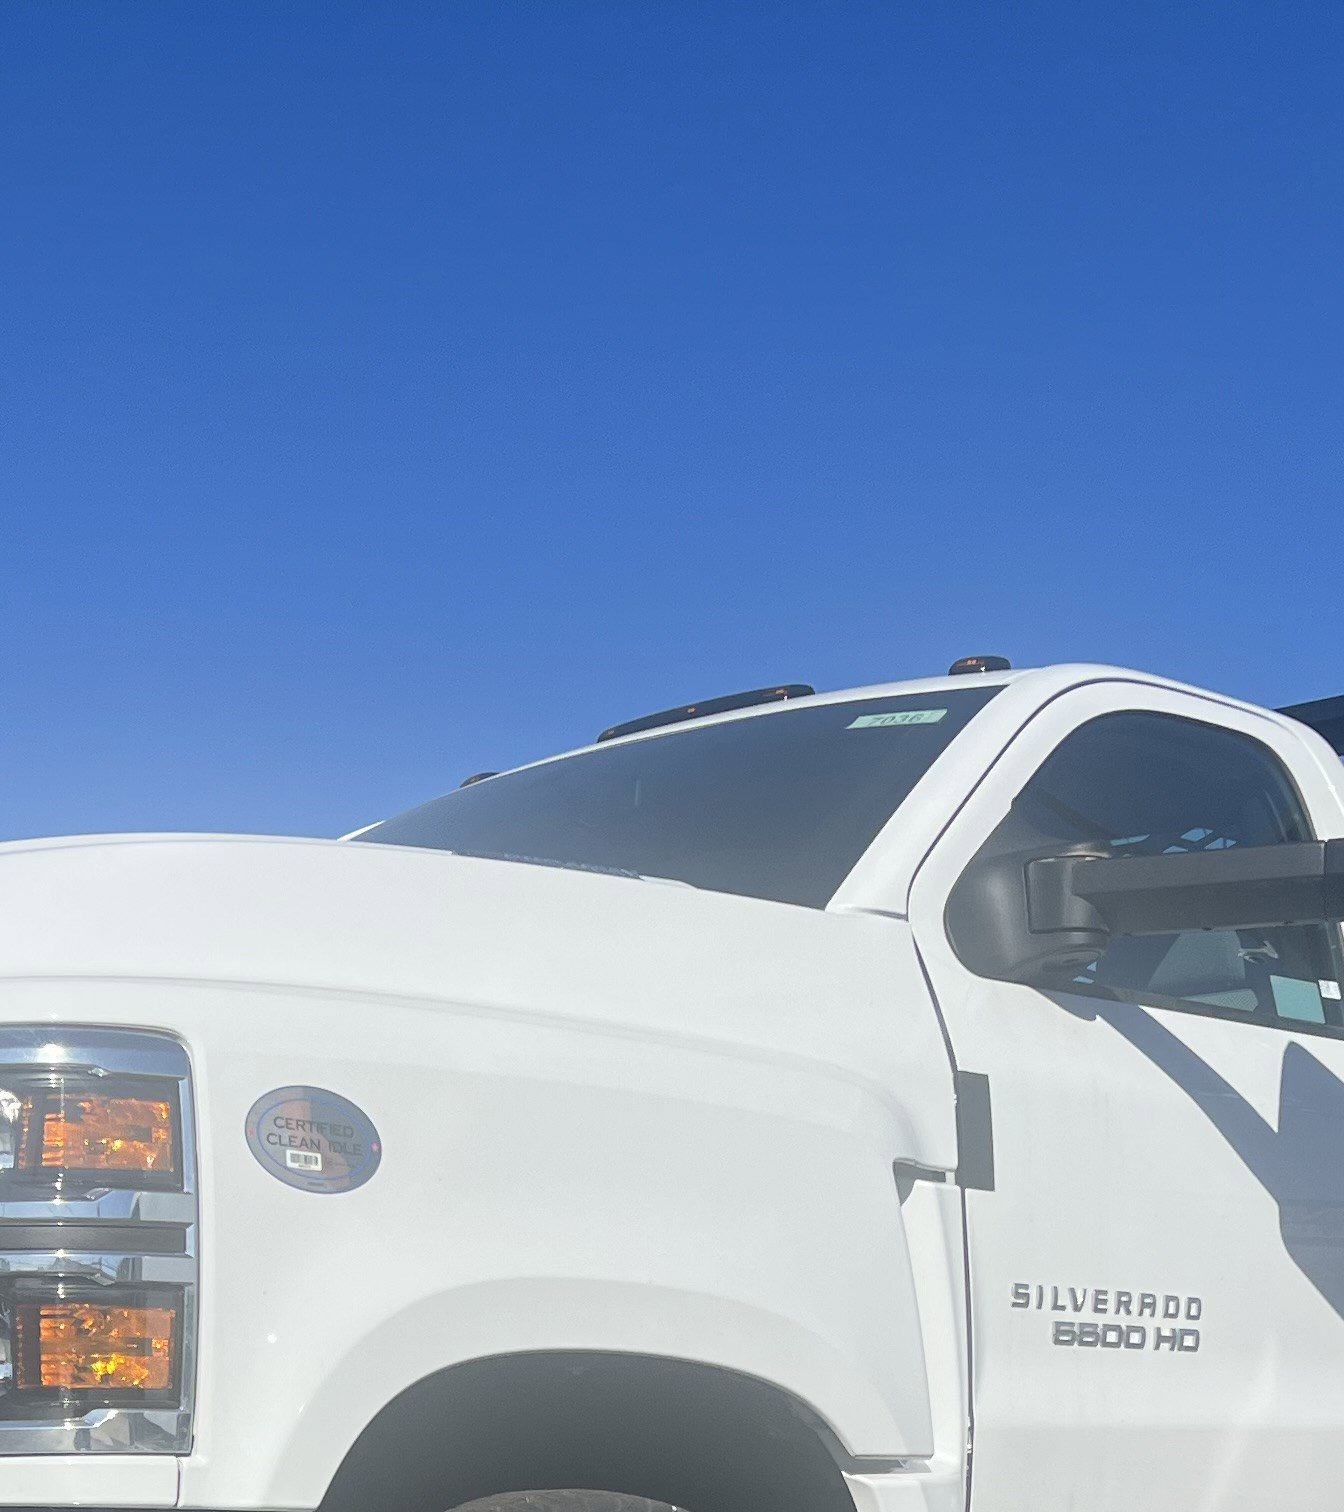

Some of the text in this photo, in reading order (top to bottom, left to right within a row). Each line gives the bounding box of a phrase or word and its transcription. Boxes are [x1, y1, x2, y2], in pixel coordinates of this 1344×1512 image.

[272, 1115, 354, 1139] CERTIFIED
[266, 1132, 364, 1156] CLEAN IDLE
[1010, 1282, 1202, 1321] SILVERADO
[1153, 1326, 1201, 1353] HD
